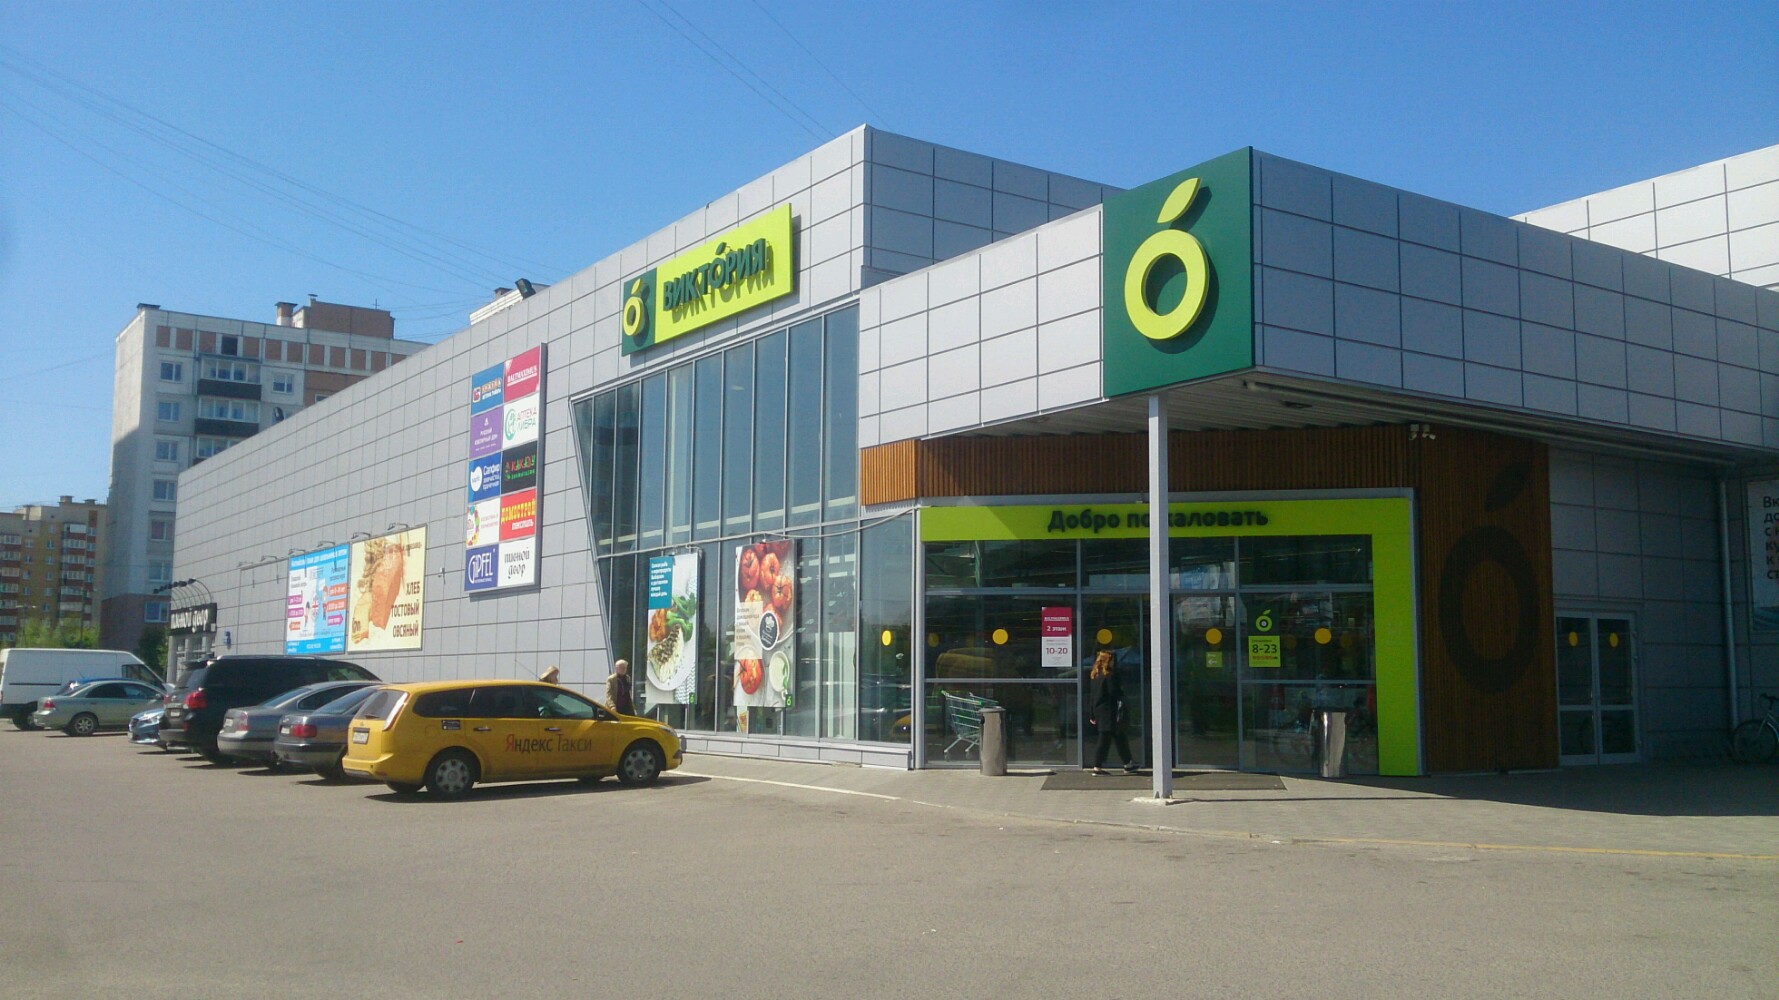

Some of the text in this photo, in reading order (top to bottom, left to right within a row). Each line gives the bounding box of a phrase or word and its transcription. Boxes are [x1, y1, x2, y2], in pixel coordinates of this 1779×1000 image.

[663, 238, 767, 312] ВИКТОРИЯ
[501, 498, 536, 525] ДОМОСТРОЙ
[1048, 509, 1269, 533] Добро поаловать
[468, 552, 493, 584] GIPFEL
[406, 581, 421, 595] ХЛЕБ
[391, 599, 420, 617] ТОСТОВЫЙ
[393, 620, 419, 638] ОВСЯНЫЙ
[1046, 647, 1068, 655] 10-20
[1252, 643, 1278, 654] 8-23
[505, 733, 592, 755] Яндекс Такси
